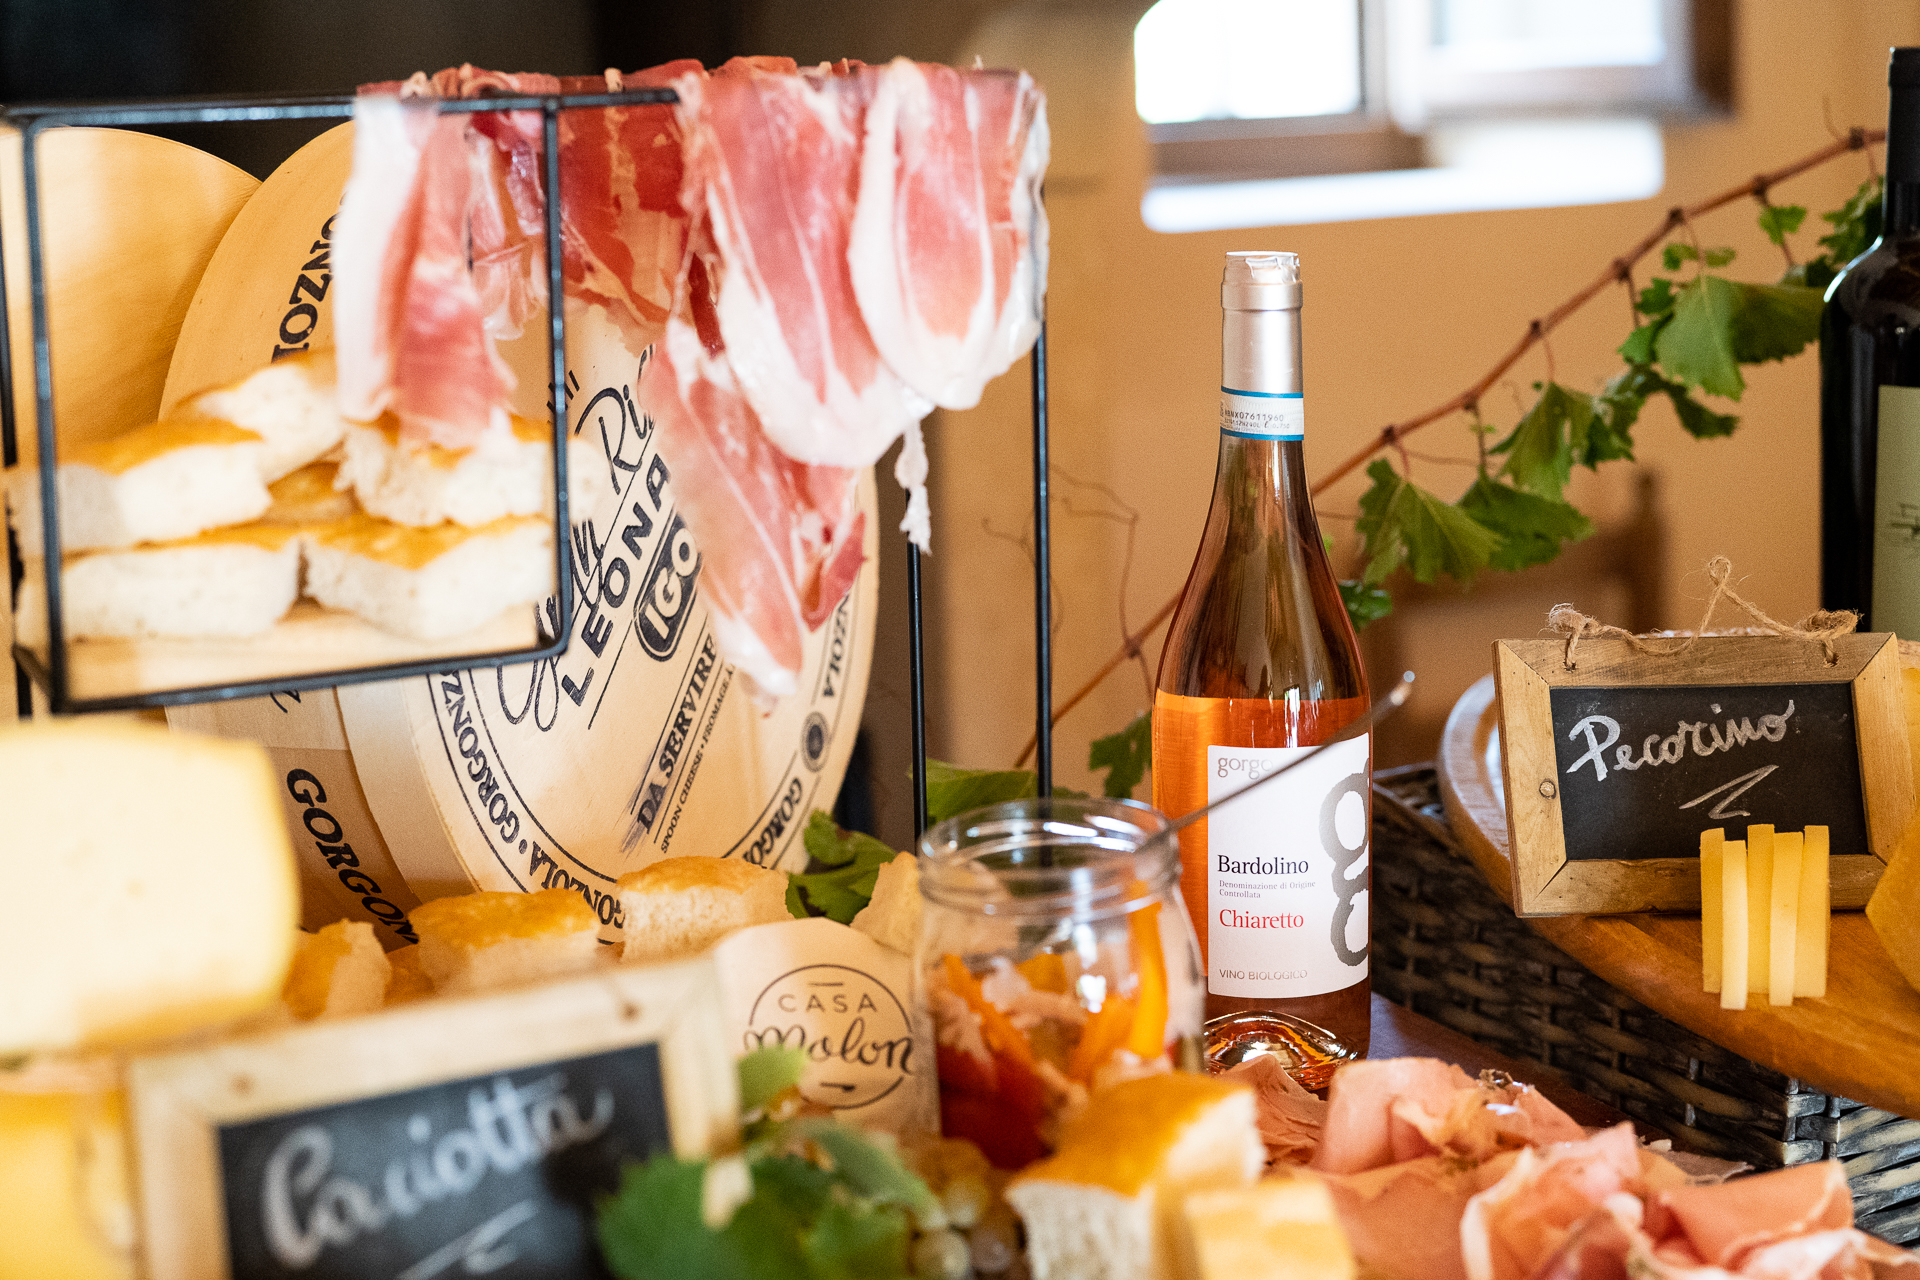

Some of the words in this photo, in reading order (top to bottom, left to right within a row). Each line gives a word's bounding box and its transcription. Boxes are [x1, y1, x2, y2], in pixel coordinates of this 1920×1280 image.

[645, 528, 698, 640] IGO
[1565, 699, 1796, 781] Pecorino
[441, 668, 520, 843] GORGONZ
[661, 804, 682, 854] SPOON
[680, 750, 703, 805] CHEESE
[702, 679, 729, 744] FROMAGE
[1217, 757, 1273, 780] gorgo
[637, 782, 668, 835] DA
[1217, 854, 1310, 875] Bardolino
[1219, 880, 1278, 890] Denominazione
[1289, 881, 1316, 891] Origine
[1219, 889, 1261, 898] Controllata
[1219, 909, 1304, 929] Chiaretto
[1219, 968, 1246, 980] VINO
[1248, 970, 1308, 980] BIOLOGICO
[778, 993, 878, 1014] CASA
[263, 1072, 614, 1268] Caciotta
